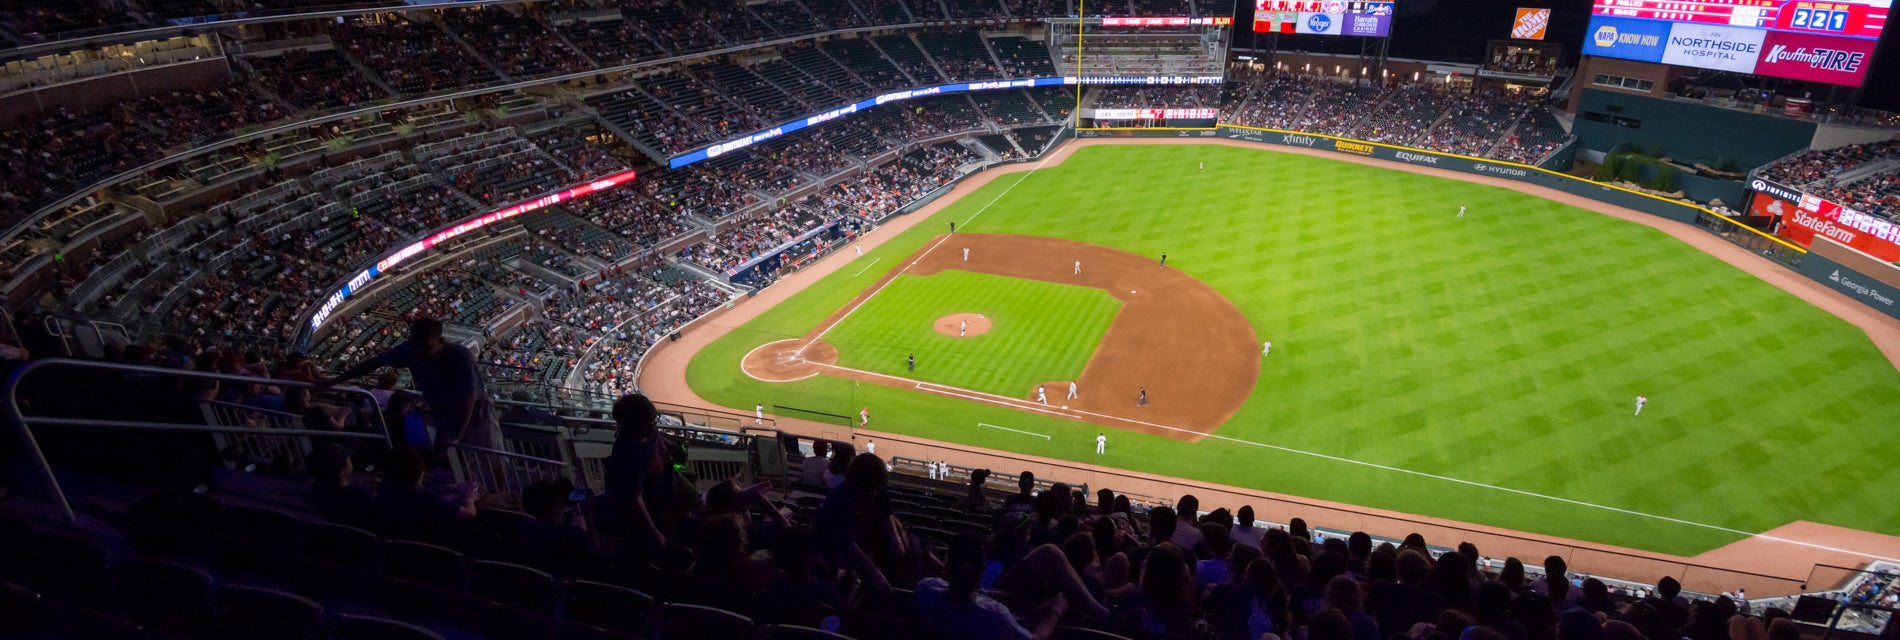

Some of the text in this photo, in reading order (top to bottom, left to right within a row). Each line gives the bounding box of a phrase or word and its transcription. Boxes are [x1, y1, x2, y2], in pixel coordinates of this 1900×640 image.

[1309, 16, 1330, 31] Kroger
[1512, 9, 1548, 38] HOME
[1518, 11, 1534, 23] THE
[1794, 11, 1845, 29] 2 2 1
[1525, 20, 1546, 38] DEPOT
[1597, 30, 1615, 42] NAPA
[1618, 32, 1660, 47] KNOW HOW
[1671, 37, 1757, 53] NORTHSIDE
[1683, 49, 1736, 60] HOSPITAL
[1765, 44, 1865, 73] Kauffman TIRE
[1282, 134, 1316, 147] xfinity
[1335, 139, 1374, 153] QUIKRETE
[1395, 151, 1439, 164] EQUIFAX
[1488, 165, 1527, 177] HYUNDAI
[1840, 276, 1895, 307] Georgia Power
